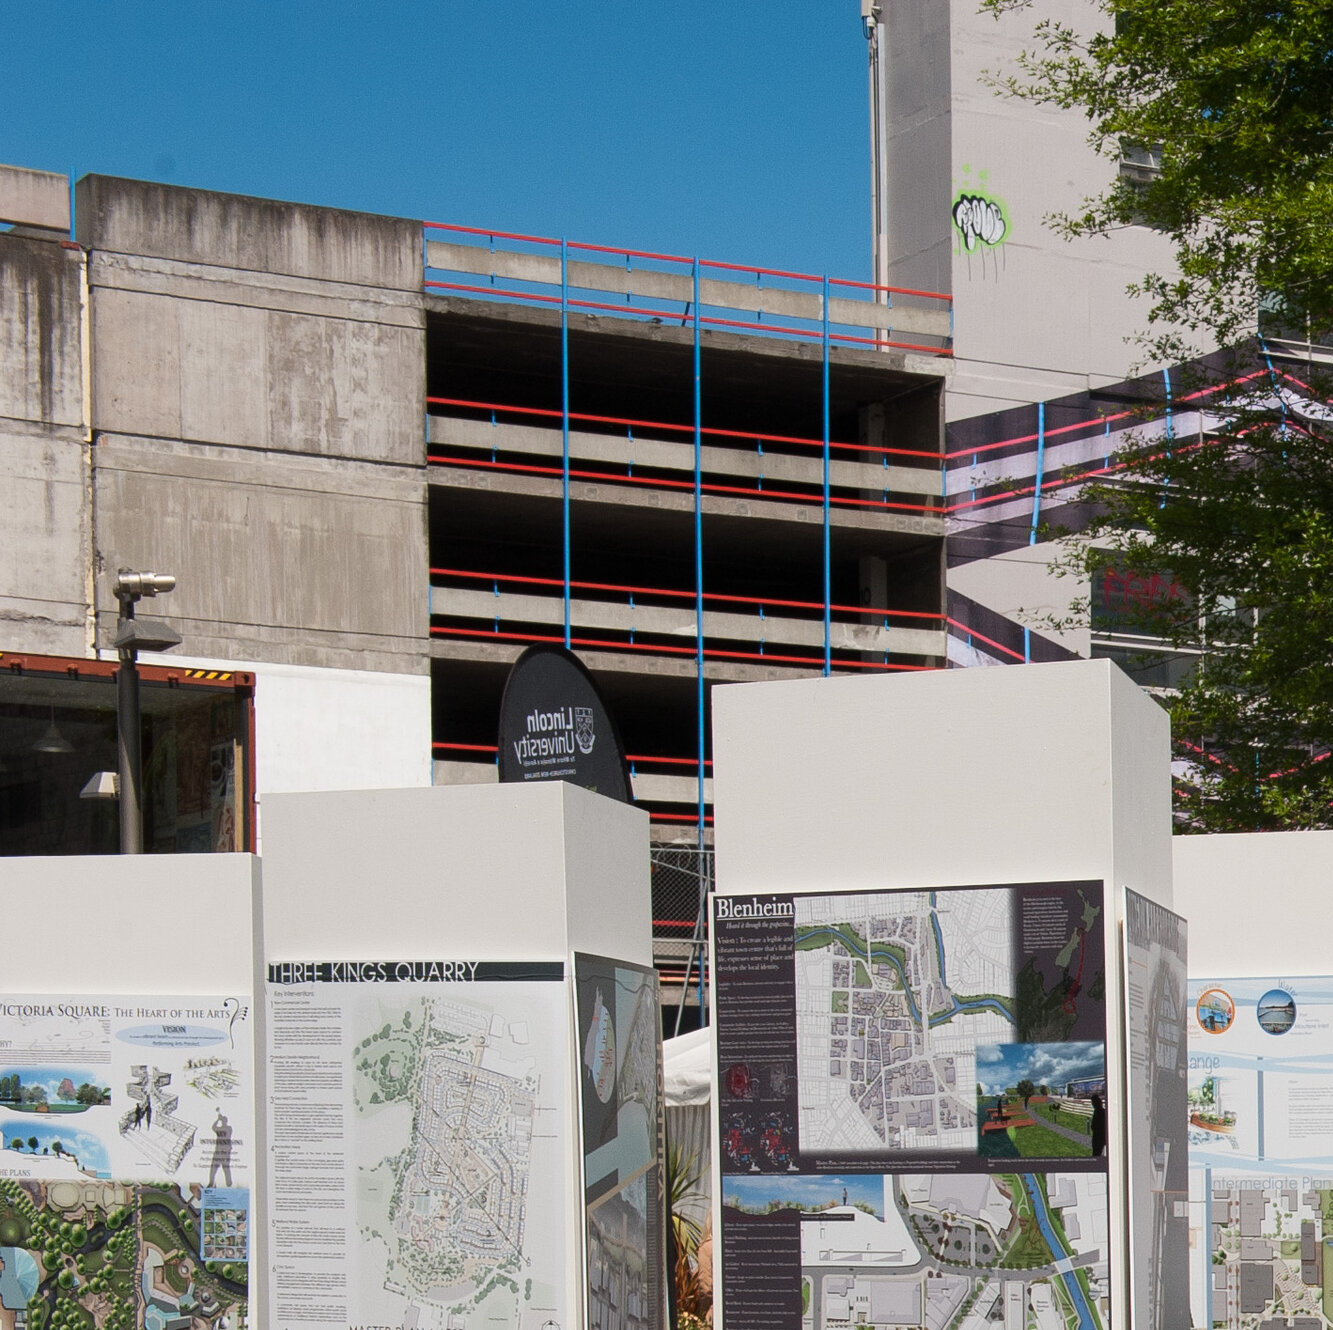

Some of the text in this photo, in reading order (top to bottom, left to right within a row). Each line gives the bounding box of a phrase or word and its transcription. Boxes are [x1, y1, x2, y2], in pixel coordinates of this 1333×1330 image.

[716, 896, 795, 918] Blenheim
[269, 961, 480, 984] THREE KINGS QUARRY
[57, 1003, 111, 1020] SQUARE:
[115, 1007, 134, 1018] THE
[136, 1008, 168, 1019] HEART
[170, 1009, 184, 1019] OF
[185, 1009, 205, 1019] THE
[207, 1009, 230, 1019] ARTS
[9, 1169, 31, 1177] PLANS
[1302, 1177, 1331, 1190] Plan
